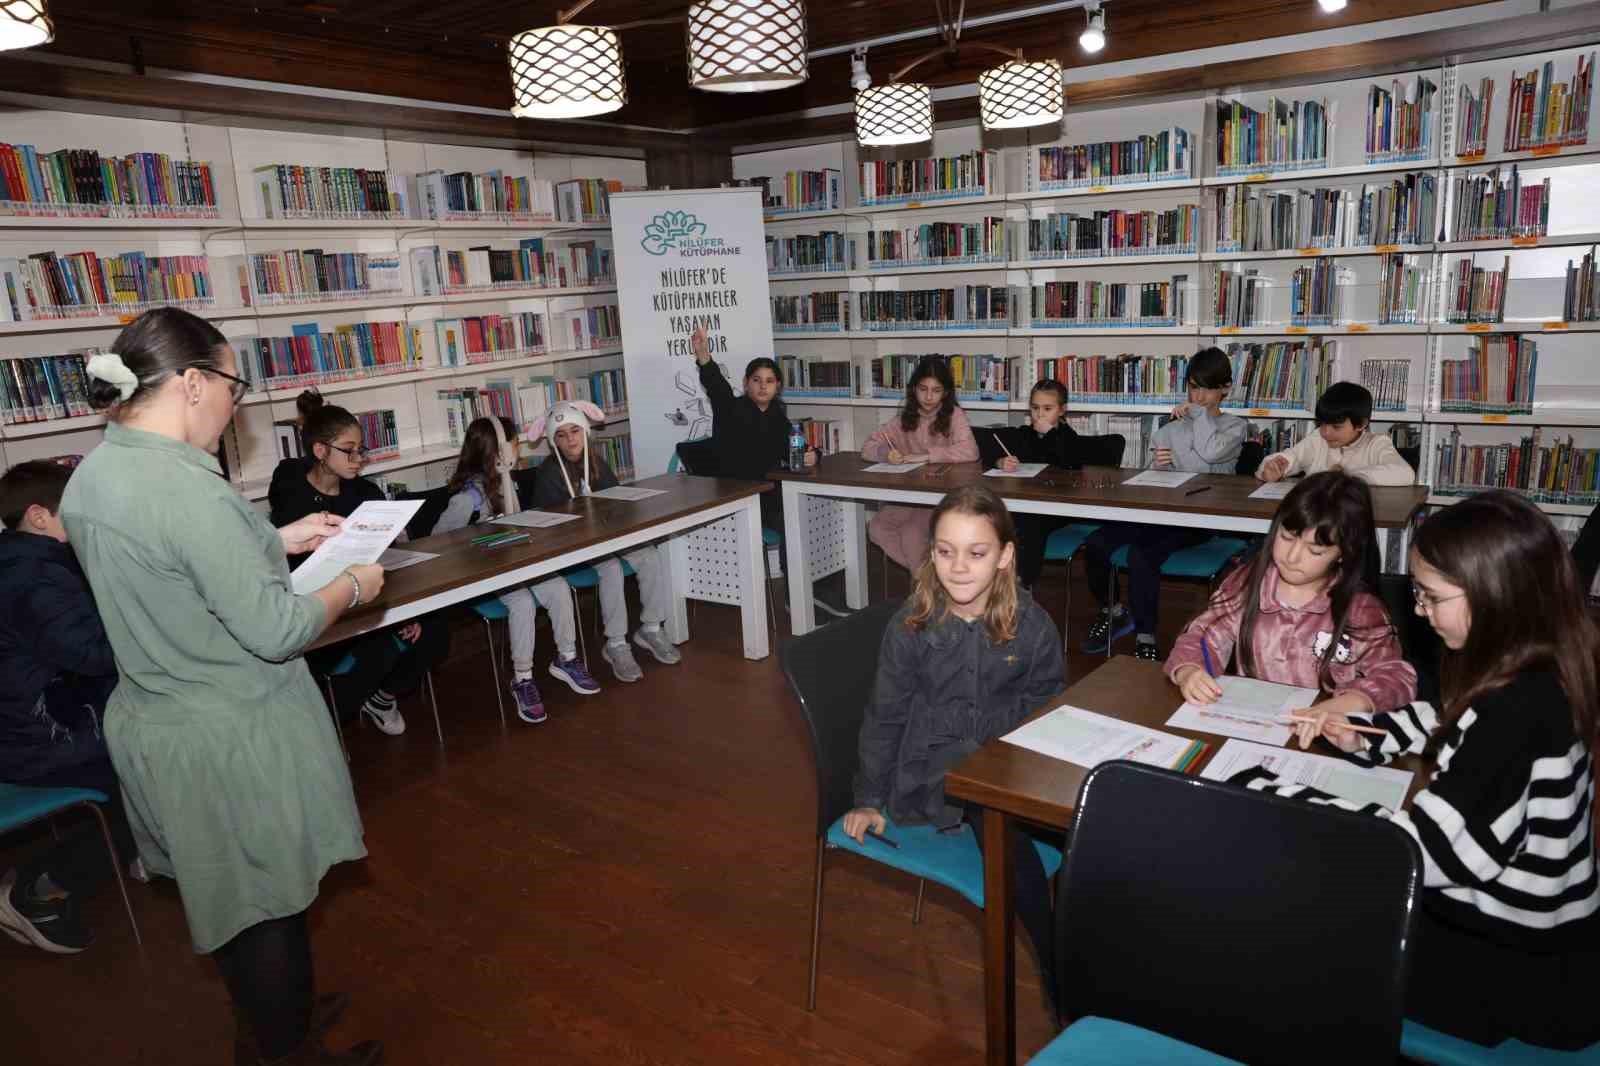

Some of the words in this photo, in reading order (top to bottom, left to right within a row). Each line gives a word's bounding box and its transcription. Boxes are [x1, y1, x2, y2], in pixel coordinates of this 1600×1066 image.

[661, 267, 727, 288] NİLÜFER'DE
[653, 289, 738, 312] KÜTÜPHANELER
[670, 313, 721, 335] YAŞAYAN
[667, 335, 727, 357] YERLDİR
